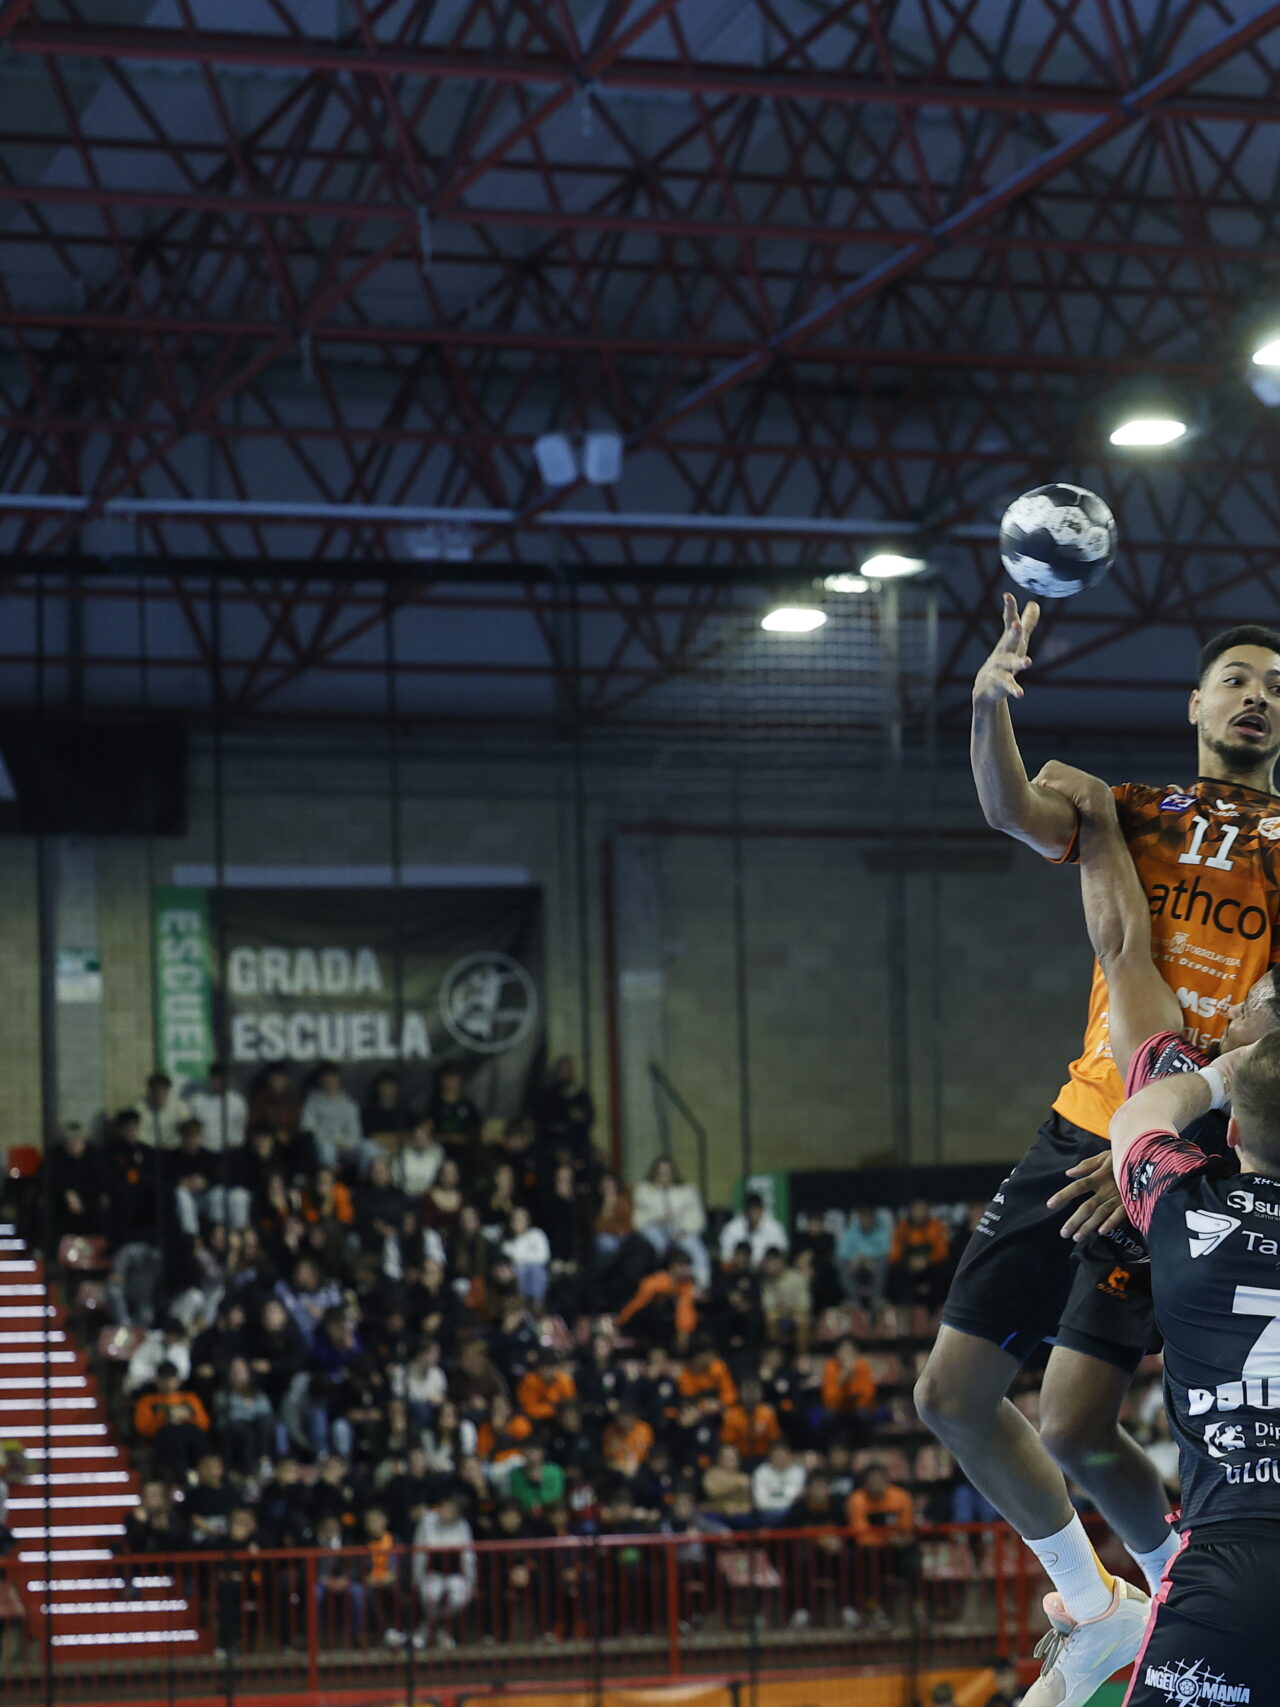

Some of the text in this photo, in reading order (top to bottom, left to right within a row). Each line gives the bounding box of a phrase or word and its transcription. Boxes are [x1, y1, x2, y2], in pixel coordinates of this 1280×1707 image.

[1178, 815, 1240, 872] 11
[1149, 877, 1267, 940] athco
[228, 946, 384, 995] GRADA
[231, 1011, 433, 1061] ESCUELA
[1144, 1665, 1251, 1704] ÁNGEL MANÍA
